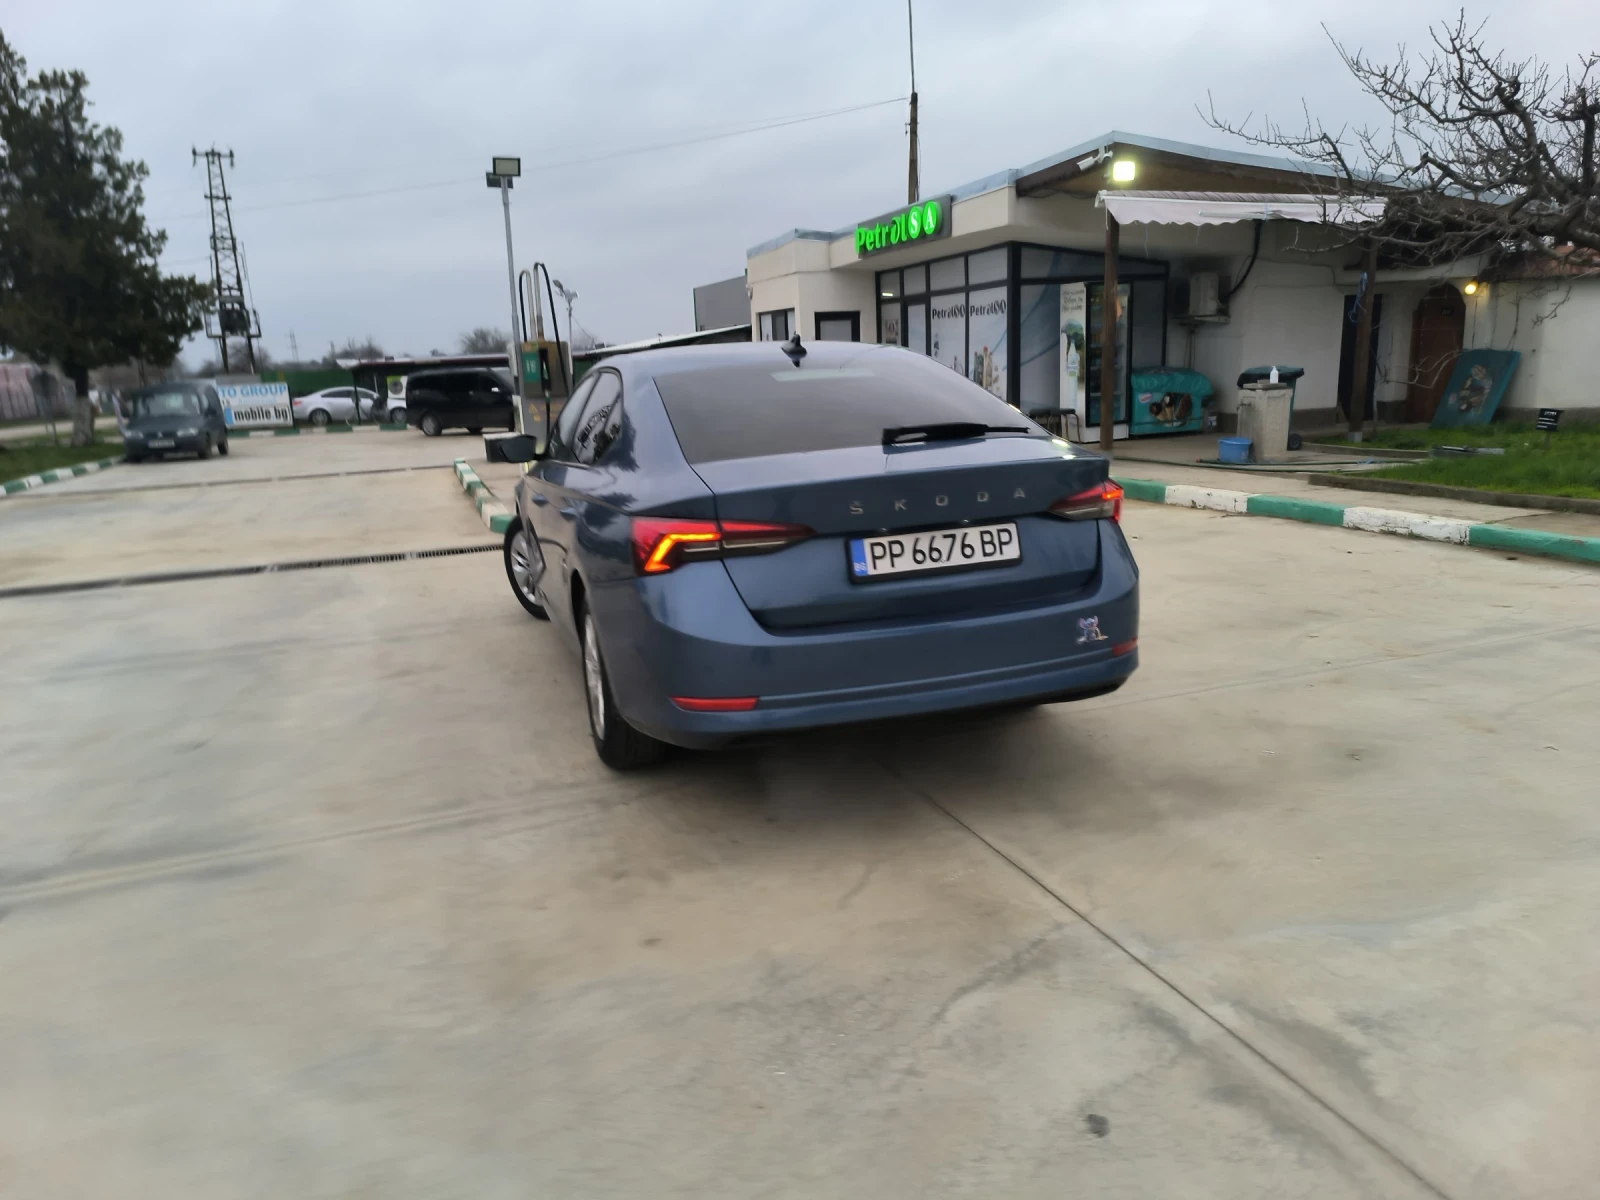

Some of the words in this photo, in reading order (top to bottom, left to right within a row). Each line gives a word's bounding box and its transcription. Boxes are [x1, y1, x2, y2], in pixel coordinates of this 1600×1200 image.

[216, 385, 237, 398] TO
[240, 383, 287, 397] GROUP
[233, 405, 288, 422] mobile.bg
[869, 539, 905, 571] PP
[912, 532, 975, 565] 6676
[979, 528, 1013, 558] BP
